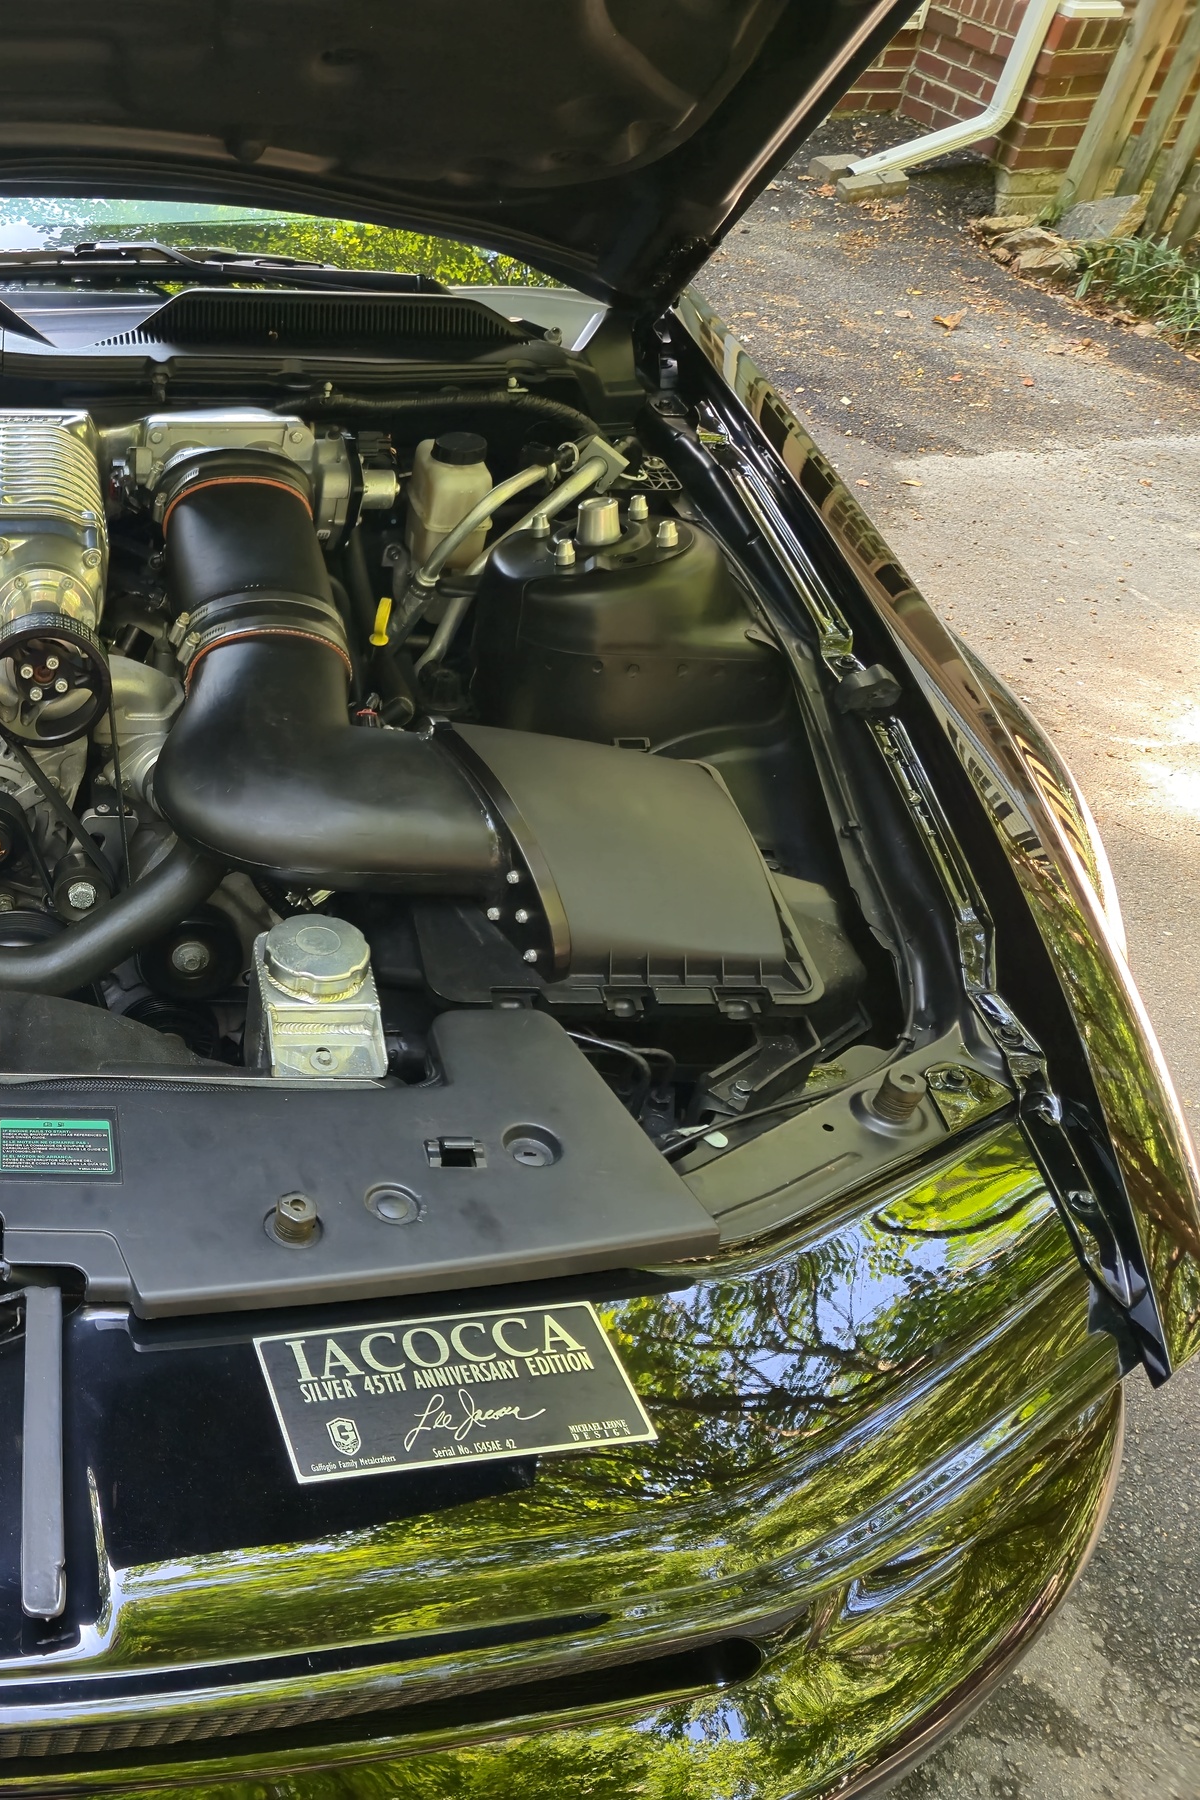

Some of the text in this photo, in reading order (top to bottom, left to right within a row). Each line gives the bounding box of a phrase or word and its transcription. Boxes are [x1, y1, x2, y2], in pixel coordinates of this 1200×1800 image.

[285, 1314, 586, 1383] IACOCCA
[300, 1351, 594, 1404] SILVER 45TH ANNIVERSARY EDITION
[568, 1419, 628, 1433] MICHAEL LEONE
[432, 1444, 456, 1458] Serial
[458, 1442, 473, 1455] No.
[506, 1438, 517, 1450] 42
[310, 1456, 396, 1472] Gaffoglio Family Metalcrafters
